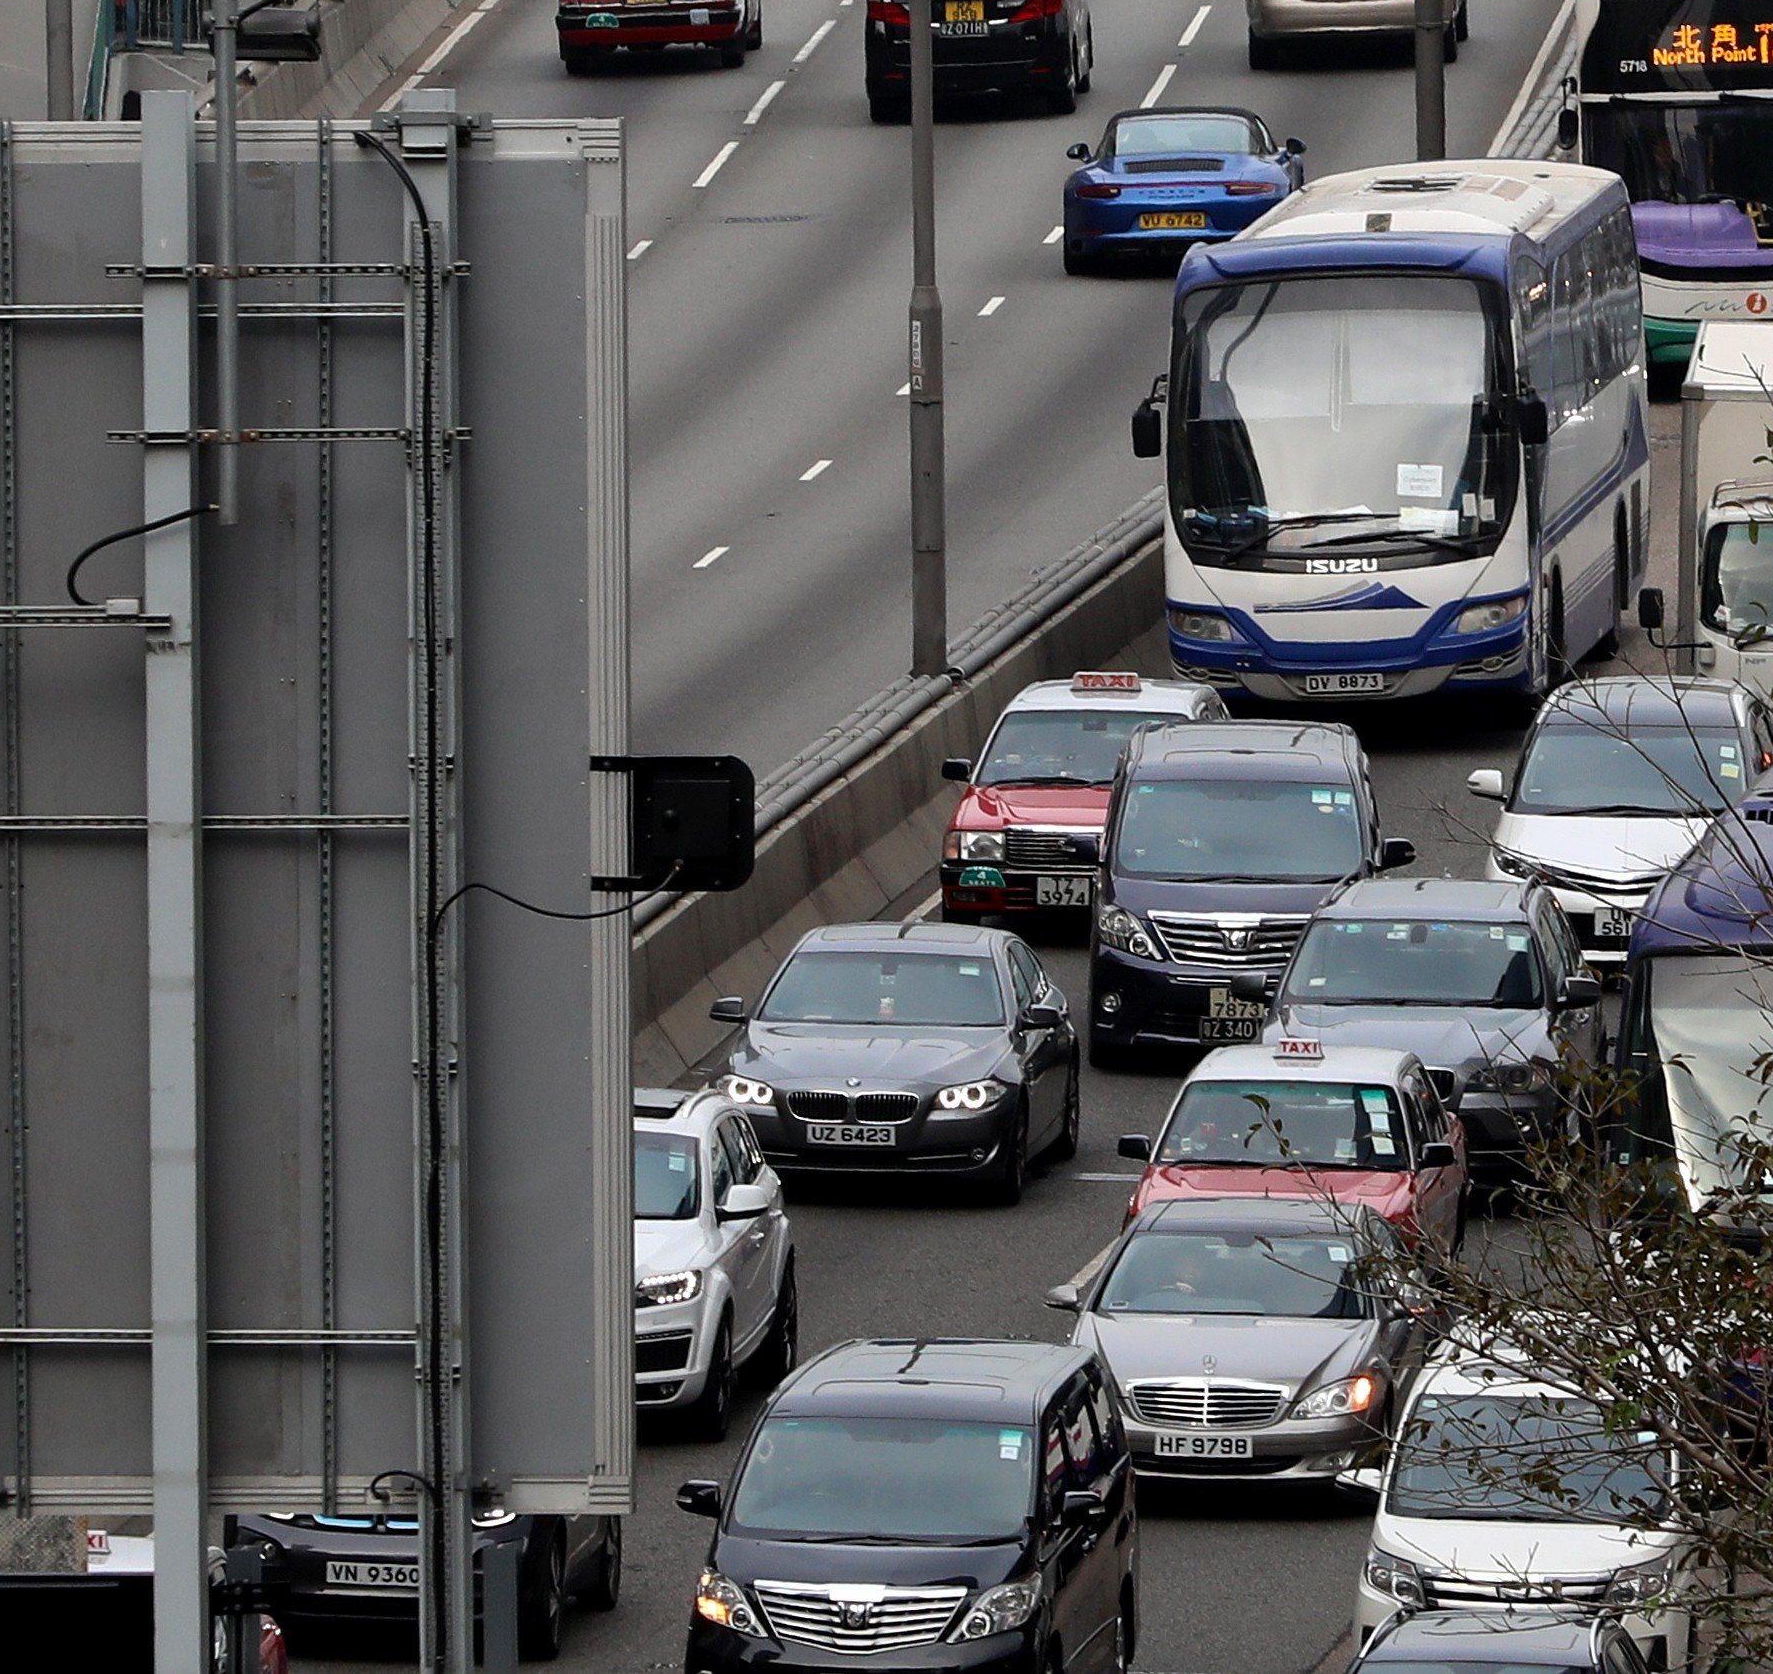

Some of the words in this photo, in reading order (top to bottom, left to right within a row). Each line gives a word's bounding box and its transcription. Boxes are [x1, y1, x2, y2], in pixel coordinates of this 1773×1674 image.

[1673, 23, 1737, 48] 北角
[1652, 47, 1706, 66] North
[1710, 44, 1757, 64] Point
[1619, 60, 1648, 73] 5718
[1141, 214, 1162, 227] VU
[1168, 213, 1204, 227] 6742
[1301, 558, 1378, 574] ISUZU
[1079, 675, 1136, 687] TAXI
[1309, 676, 1330, 690] DV
[1338, 675, 1379, 689] 8873
[976, 871, 987, 880] 4
[1055, 877, 1074, 889] TZ
[1039, 890, 1086, 905] 3974
[1214, 1002, 1259, 1017] 7873
[1280, 1040, 1318, 1054] TAXI
[811, 1127, 836, 1141] UZ
[840, 1127, 892, 1142] 6423
[1160, 1437, 1186, 1453] HF
[1191, 1437, 1248, 1455] 9798
[330, 1564, 357, 1582] VN
[368, 1564, 419, 1584] 9360
